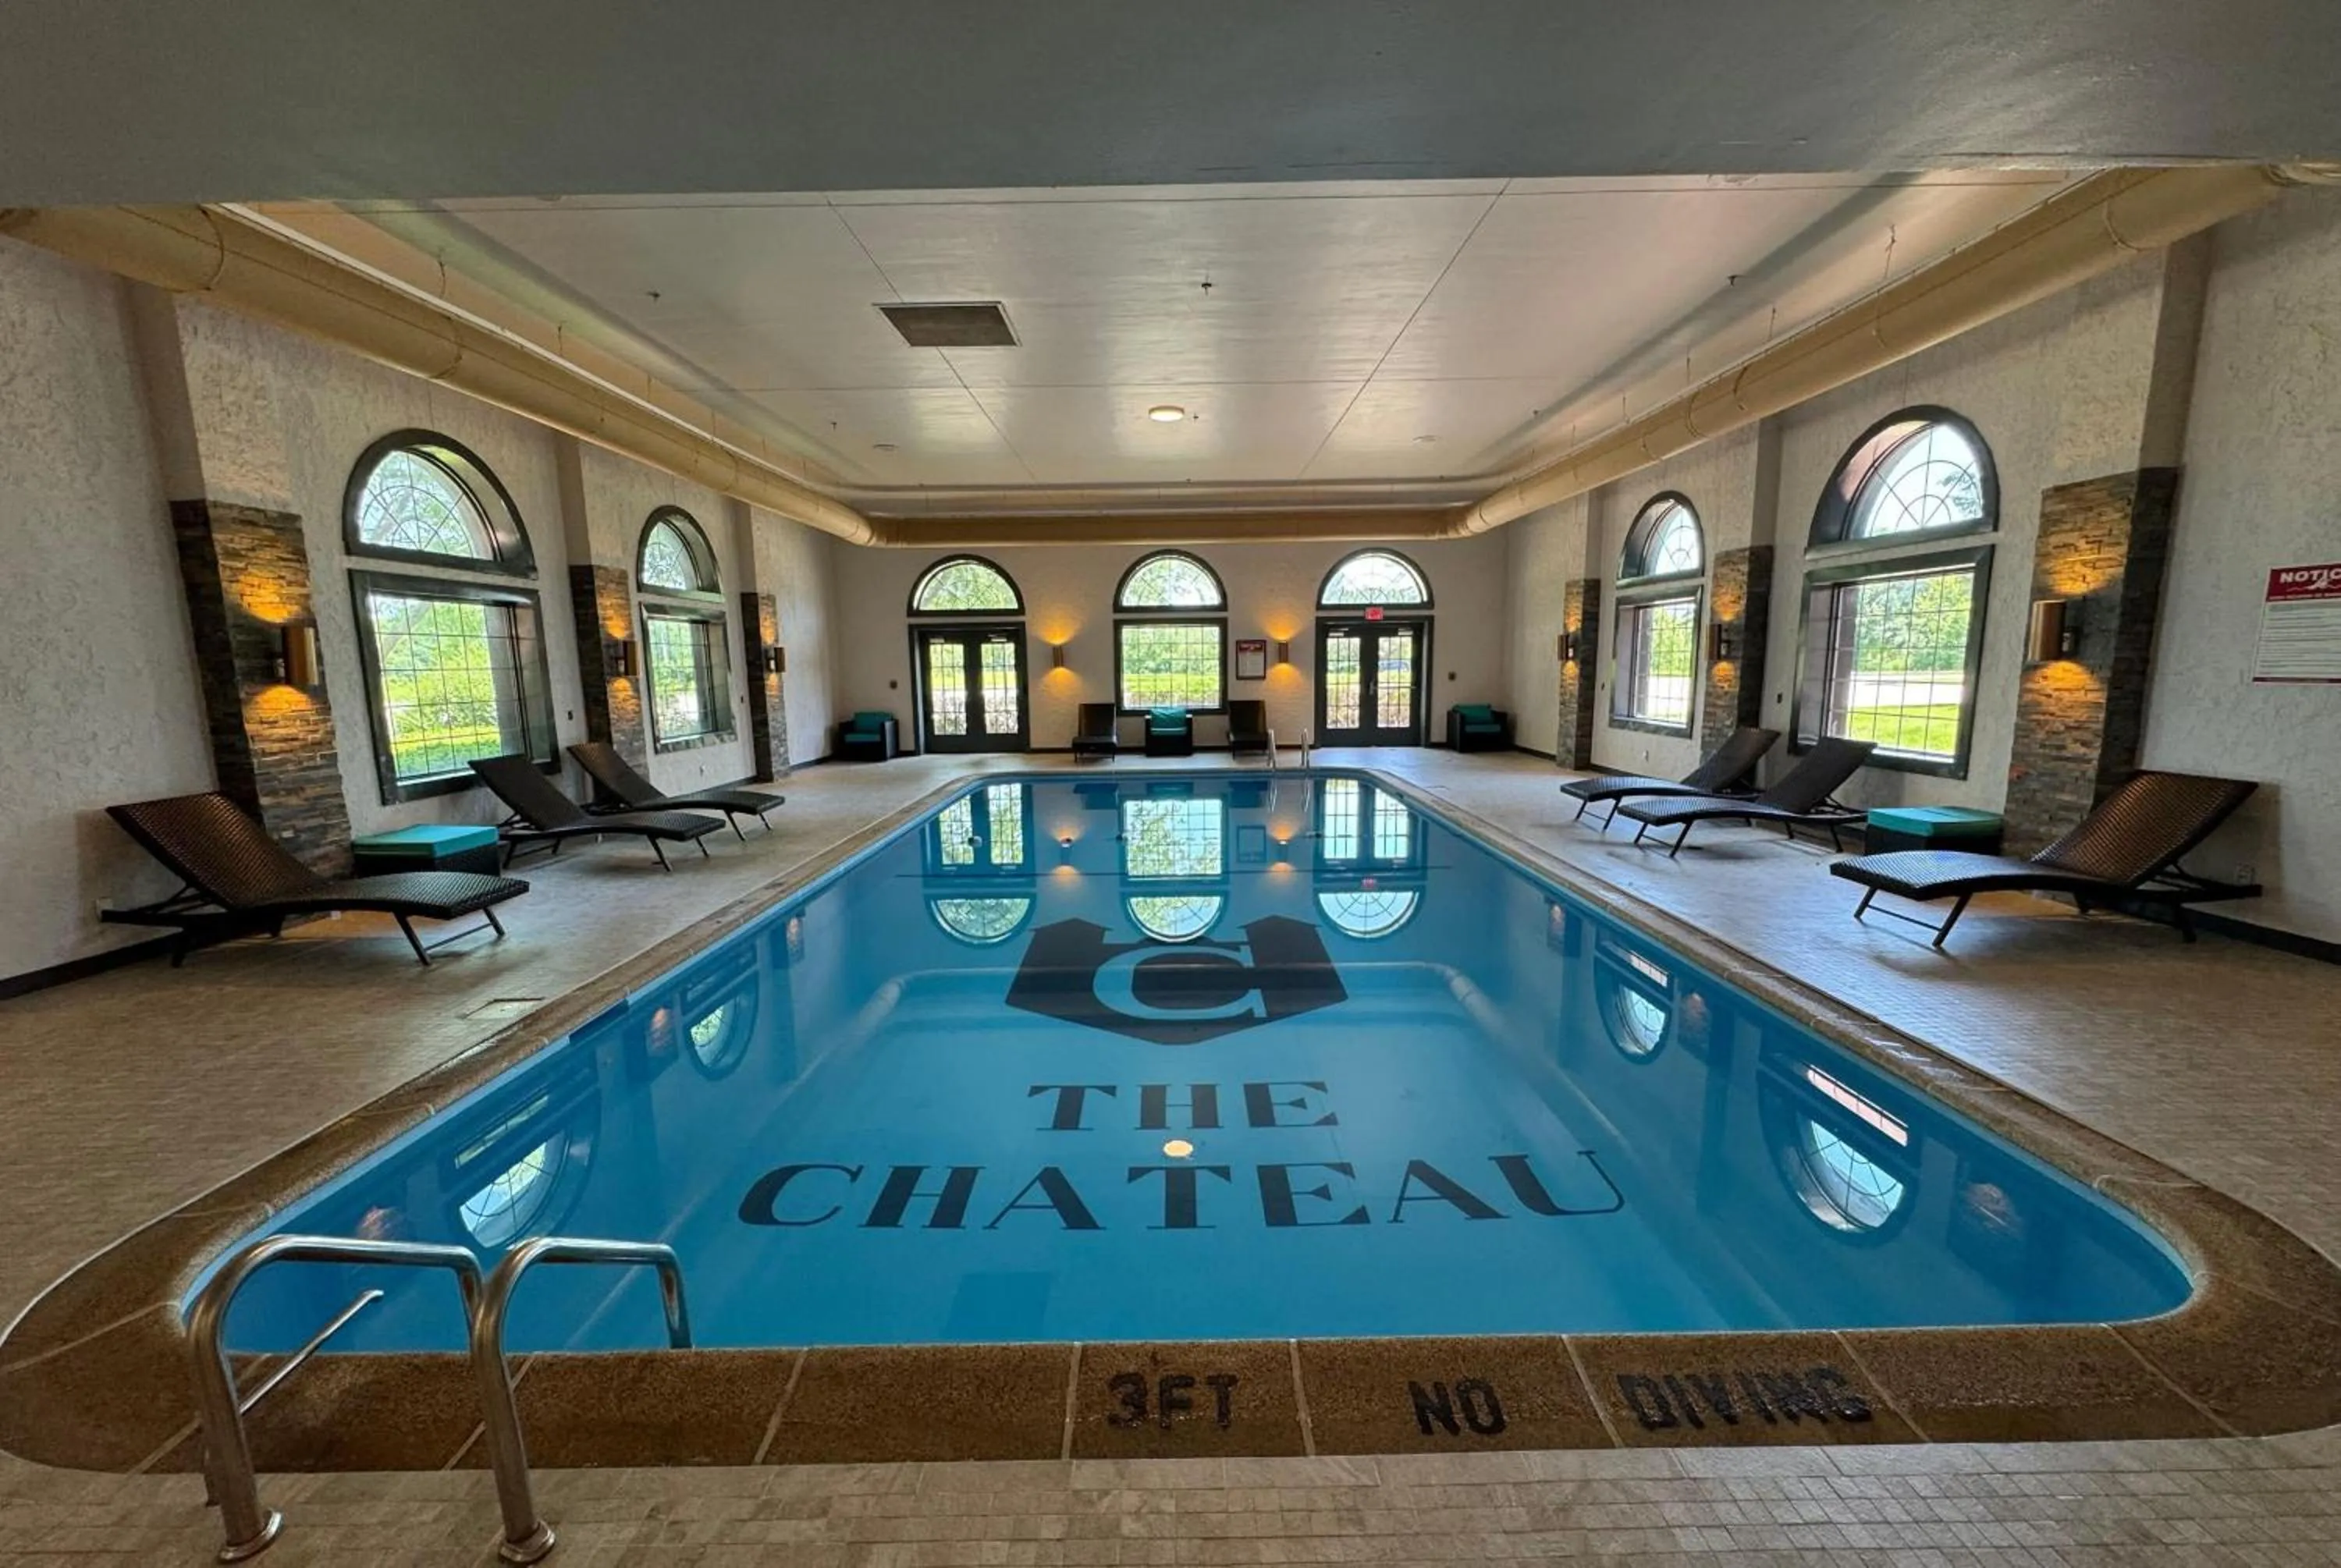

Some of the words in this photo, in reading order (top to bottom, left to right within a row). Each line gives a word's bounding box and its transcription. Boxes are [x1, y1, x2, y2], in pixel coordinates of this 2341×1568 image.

[1093, 945, 1268, 1020] C
[1028, 1081, 1339, 1130] THE
[737, 1149, 1625, 1231] CHATEAU
[1107, 1372, 1240, 1431] 3FT
[1408, 1377, 1506, 1436] NO
[1617, 1367, 1873, 1431] DIVING
